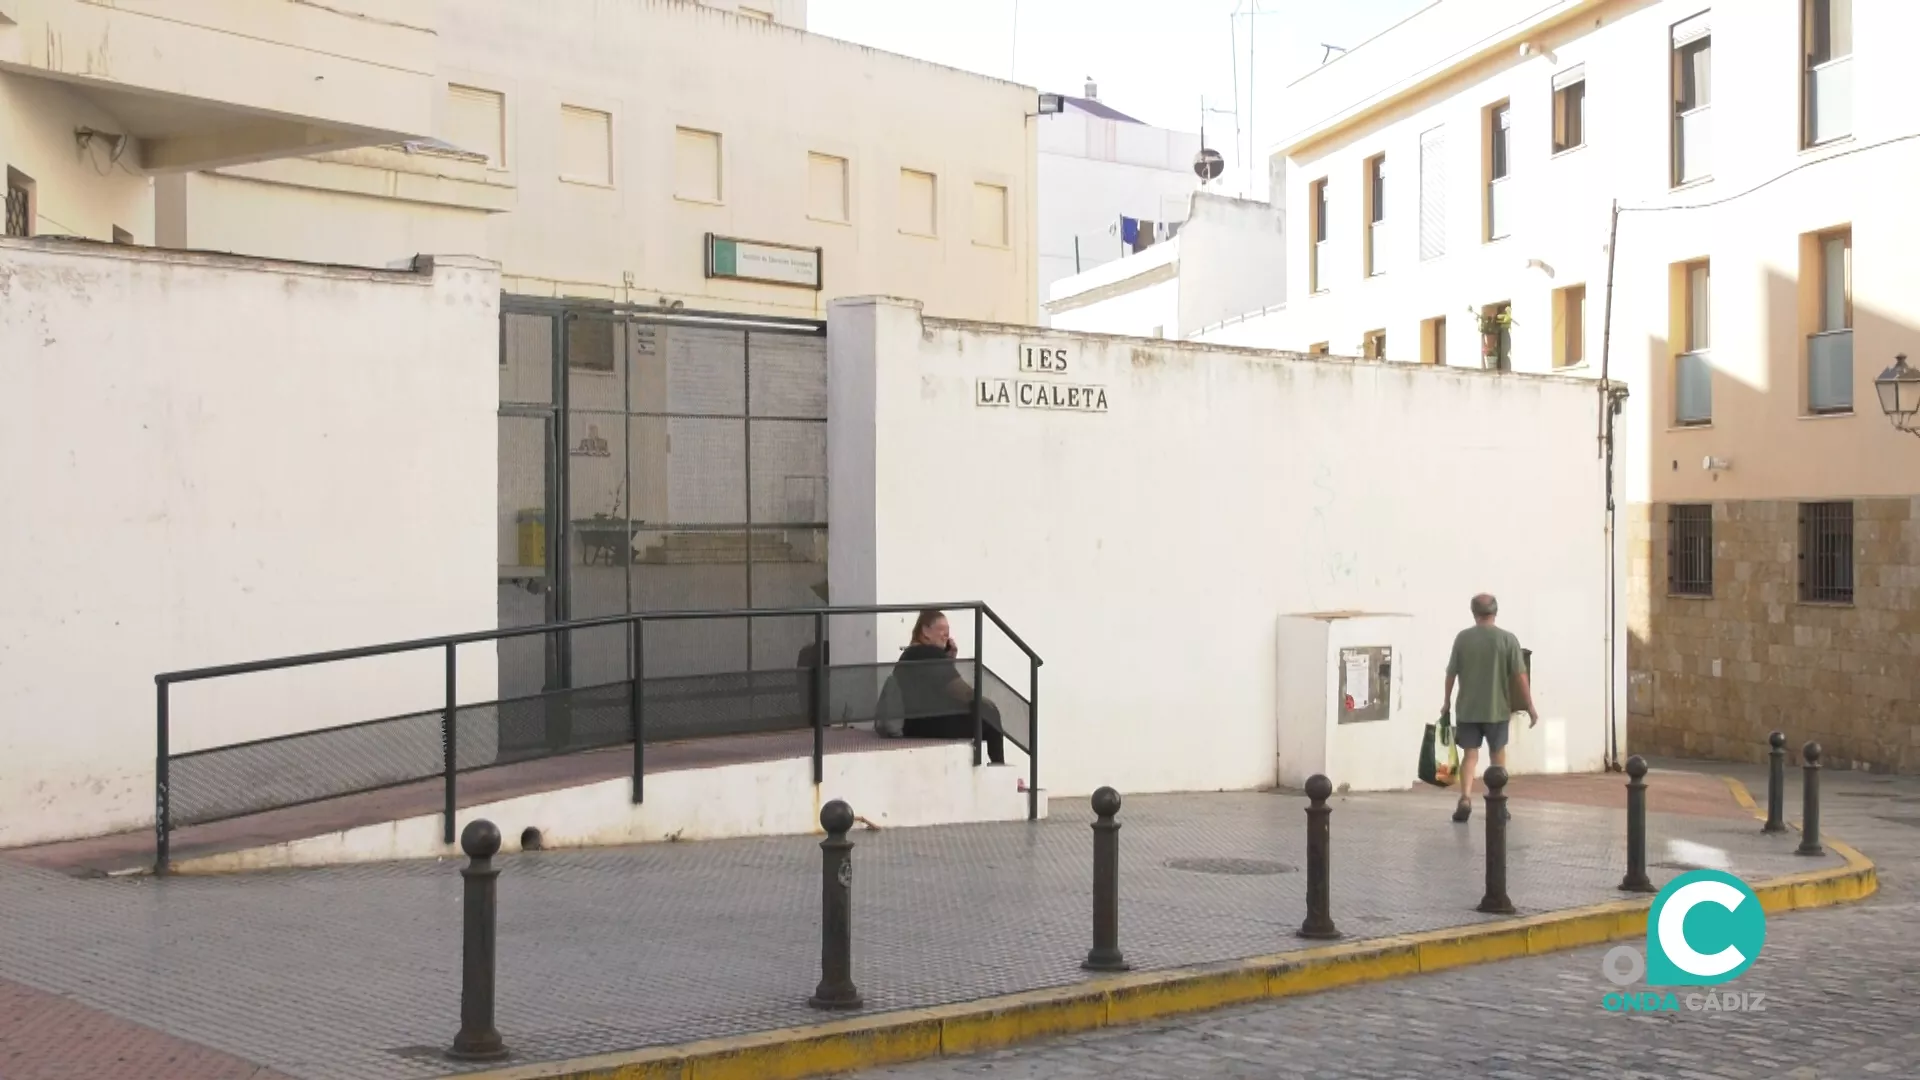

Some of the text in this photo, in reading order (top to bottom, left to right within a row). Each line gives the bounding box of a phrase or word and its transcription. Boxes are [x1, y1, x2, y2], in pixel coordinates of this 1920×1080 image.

[1026, 348, 1068, 371] IES
[981, 381, 1108, 409] LA CALETA
